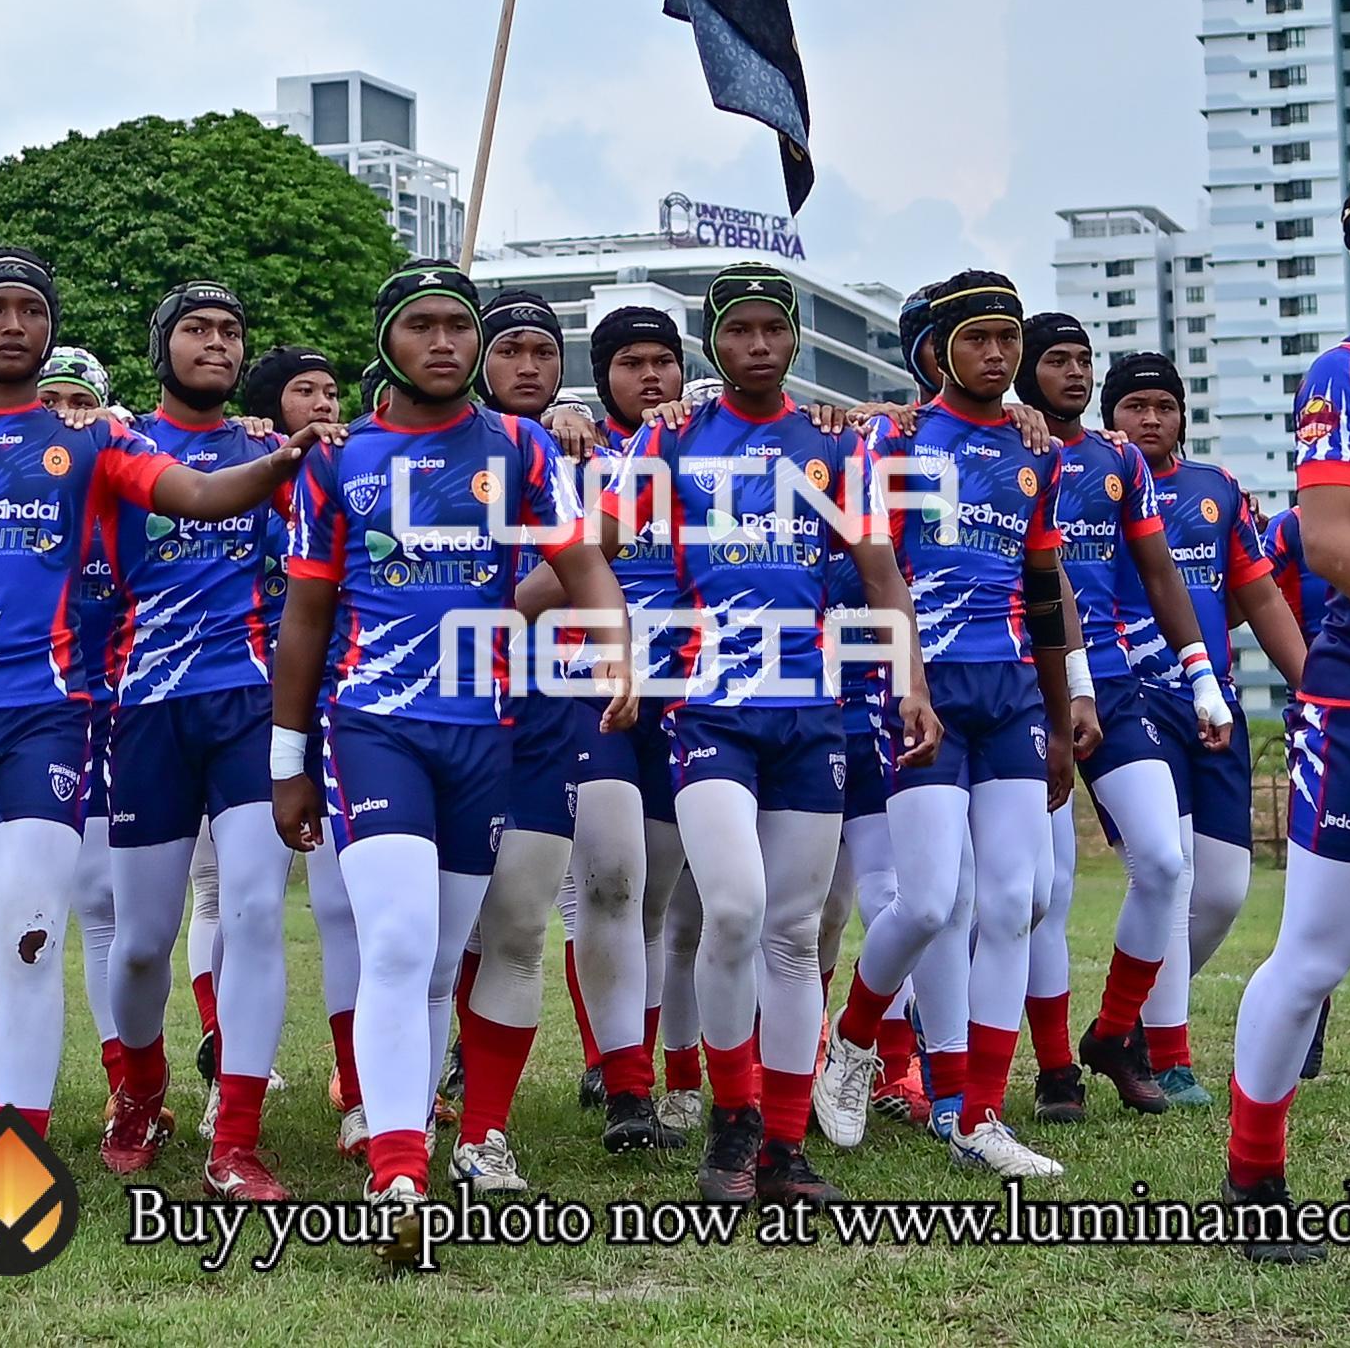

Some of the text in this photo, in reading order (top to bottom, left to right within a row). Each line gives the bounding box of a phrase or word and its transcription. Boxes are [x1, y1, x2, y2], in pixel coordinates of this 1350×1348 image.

[695, 202, 788, 231] UNIVERSITY OF
[742, 511, 820, 538] Pandai
[401, 530, 493, 559] Pandai
[1168, 543, 1216, 561] andai
